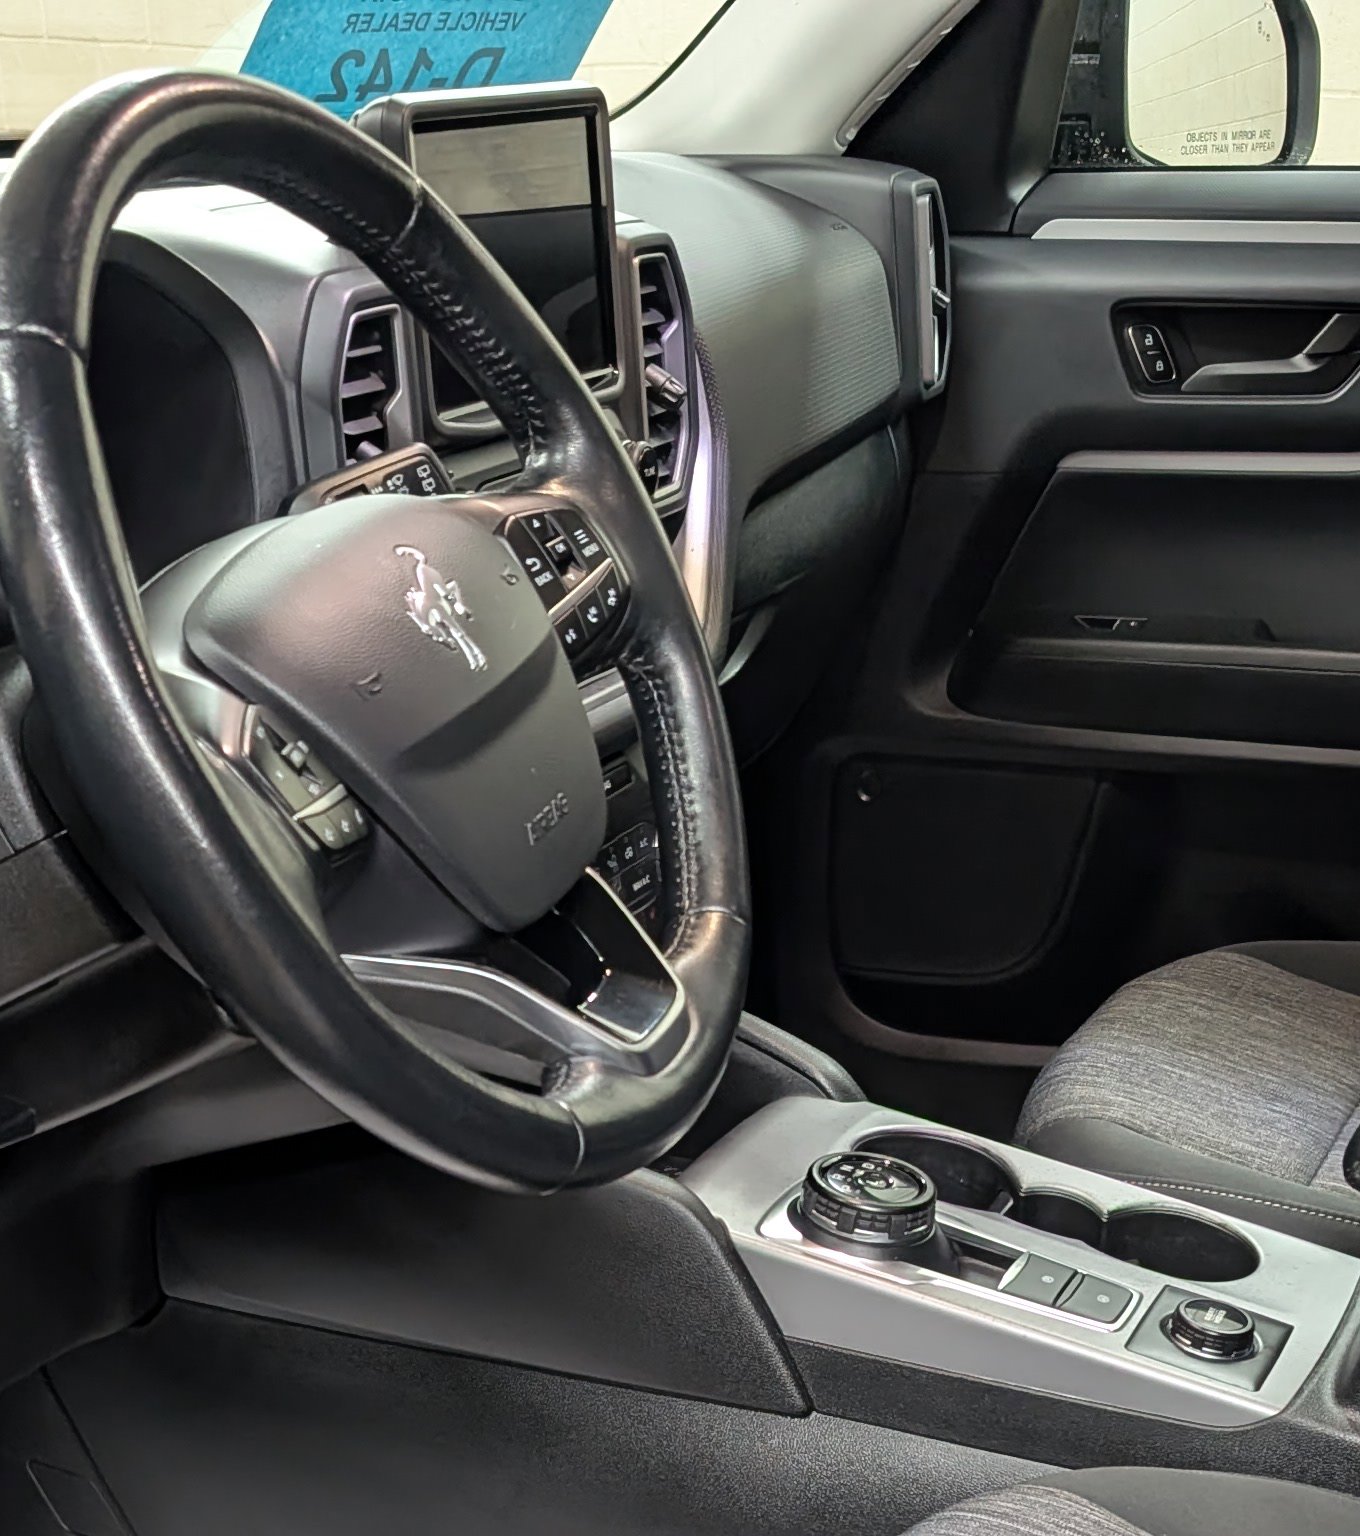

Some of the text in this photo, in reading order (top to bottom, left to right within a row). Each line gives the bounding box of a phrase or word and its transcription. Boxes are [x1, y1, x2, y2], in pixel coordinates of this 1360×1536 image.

[1186, 129, 1271, 143] OBJECTS IN MIRROR ARE
[1180, 141, 1275, 156] CLOSER THAN THEY APPEAR
[534, 571, 554, 587] BACK
